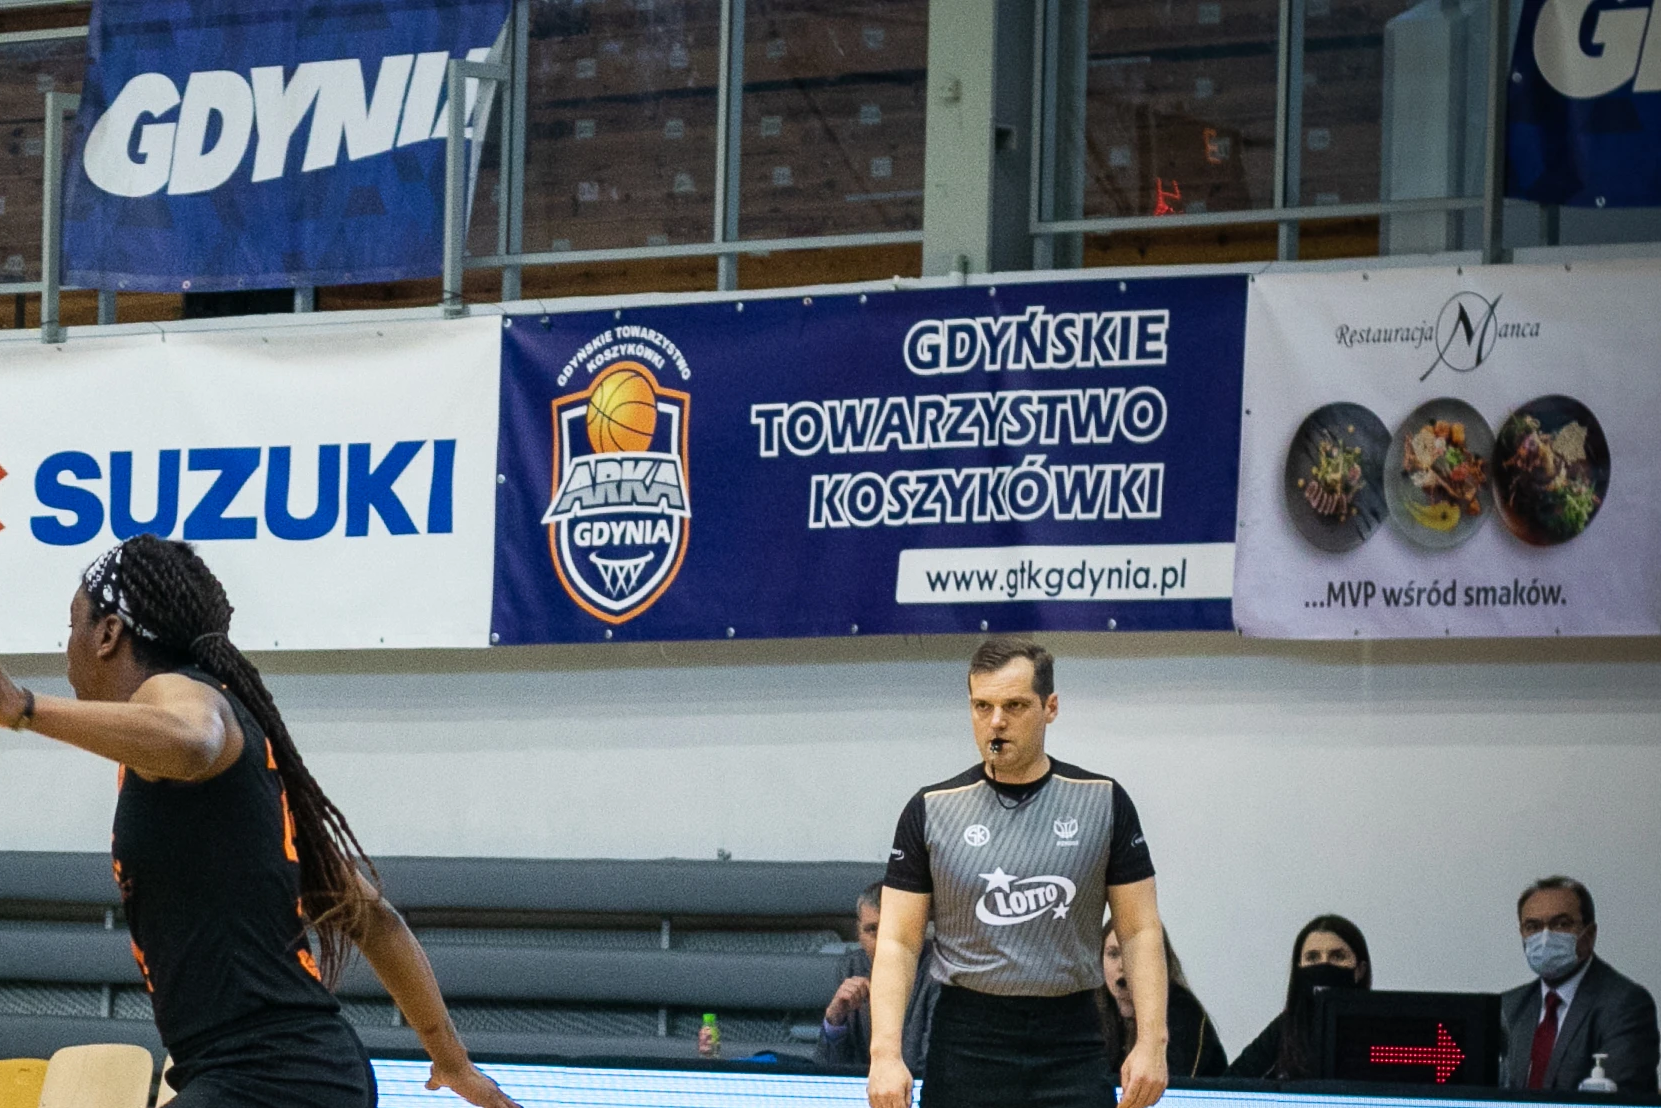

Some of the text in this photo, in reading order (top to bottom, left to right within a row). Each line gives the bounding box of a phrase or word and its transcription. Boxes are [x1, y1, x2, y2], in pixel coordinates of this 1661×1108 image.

[615, 325, 691, 381] TOWARZYSTWO
[904, 305, 1169, 376] GDYŃSKIE
[1335, 319, 1434, 349] Restauracja
[586, 343, 665, 374] KOSZYKÓWKI
[751, 386, 1168, 457] TOWARZYSTWO
[31, 438, 457, 547] SUZUKI
[550, 458, 686, 516] ARKA
[808, 454, 1165, 530] KOSZYKÓWKI
[574, 519, 671, 547] GDYNIA
[926, 558, 1187, 597] www.gtkgdynia.pl
[1382, 579, 1457, 608] wśród
[1463, 580, 1567, 607] smaków.
[994, 884, 1058, 915] LOTTO
